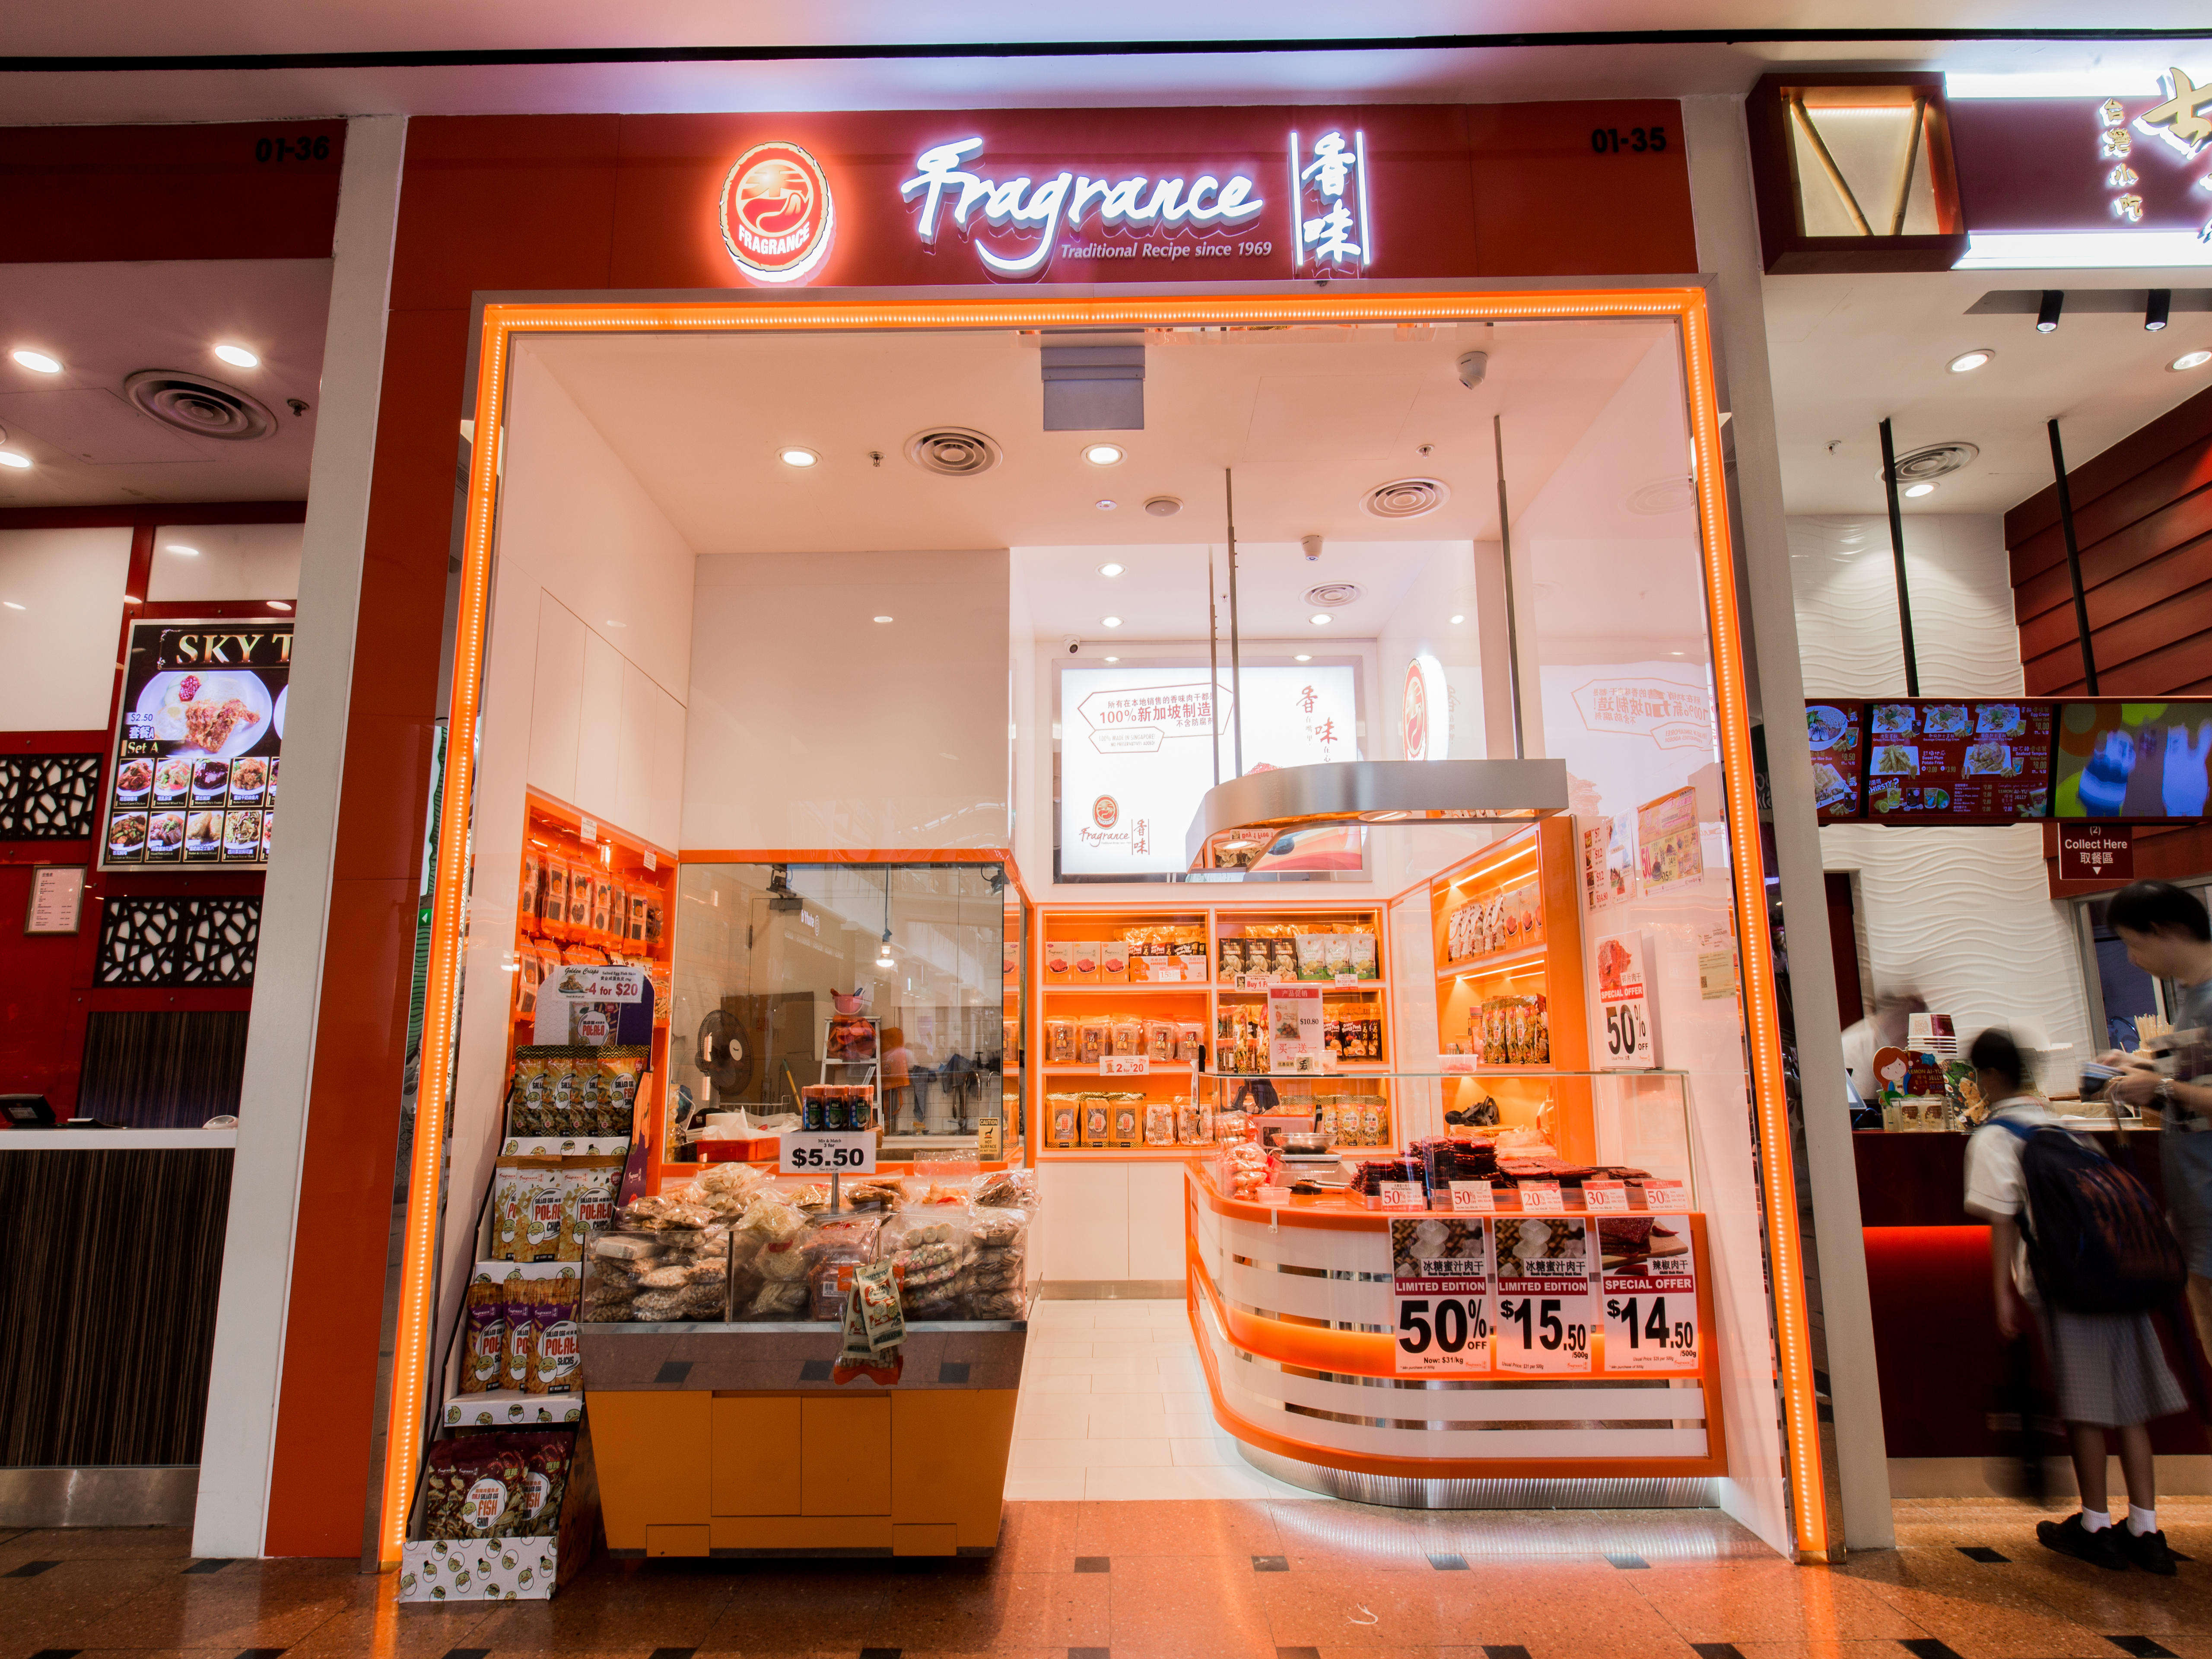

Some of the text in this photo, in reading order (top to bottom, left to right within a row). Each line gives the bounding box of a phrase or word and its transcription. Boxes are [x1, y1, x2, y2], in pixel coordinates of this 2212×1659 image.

[1592, 127, 1666, 153] 01-35
[256, 136, 330, 162] 01-36
[2102, 98, 2143, 219] 台灣小吃
[1301, 131, 1362, 264] 香味
[901, 137, 1263, 275] Fragrance
[738, 221, 810, 255] FRAGRANCE
[1061, 241, 1272, 262] Traditional Recipe since 1969
[176, 634, 264, 664] SKY
[130, 714, 153, 722] $2.50
[2035, 722, 2049, 730] $8.00
[127, 741, 159, 754] Set A
[1079, 826, 1130, 847] Fragrance
[1134, 819, 1148, 855] 香味
[2090, 826, 2101, 836] (2)
[2065, 839, 2127, 849] Collect Here
[2080, 852, 2113, 864] 取餐區
[565, 967, 581, 975] Golden
[600, 982, 638, 997] for $20
[1247, 981, 1257, 989] Buy
[1601, 986, 1643, 999] SPECIAL OFFER
[1605, 1004, 1646, 1055] 50%
[1278, 1043, 1317, 1054] 买一送一
[1116, 1063, 1122, 1072] 2
[1130, 1063, 1144, 1072] $20
[791, 1147, 864, 1169] $5.50
[1384, 1191, 1406, 1204] 50%
[1454, 1191, 1476, 1204] 50%
[1523, 1192, 1545, 1206] 20%
[1587, 1191, 1609, 1205] 30%
[1647, 1190, 1669, 1204] 50%
[1423, 1260, 1484, 1272] 冰糖蜜汁肉干
[1526, 1260, 1586, 1272] 冰糖蜜汁肉干
[1652, 1259, 1688, 1271] 辣椒肉干
[1396, 1282, 1485, 1291] LIMITED EDITION
[1499, 1282, 1587, 1291] LIMITED EDITION
[1605, 1278, 1692, 1290] SPECIAL OFFER
[1399, 1298, 1487, 1354] 50%
[1500, 1298, 1588, 1360] $15.50 /500g
[1607, 1297, 1693, 1349] $14.50
[1468, 1341, 1487, 1350] OFF
[1442, 1357, 1463, 1365] $31/kg
[478, 1499, 498, 1516] FISH
